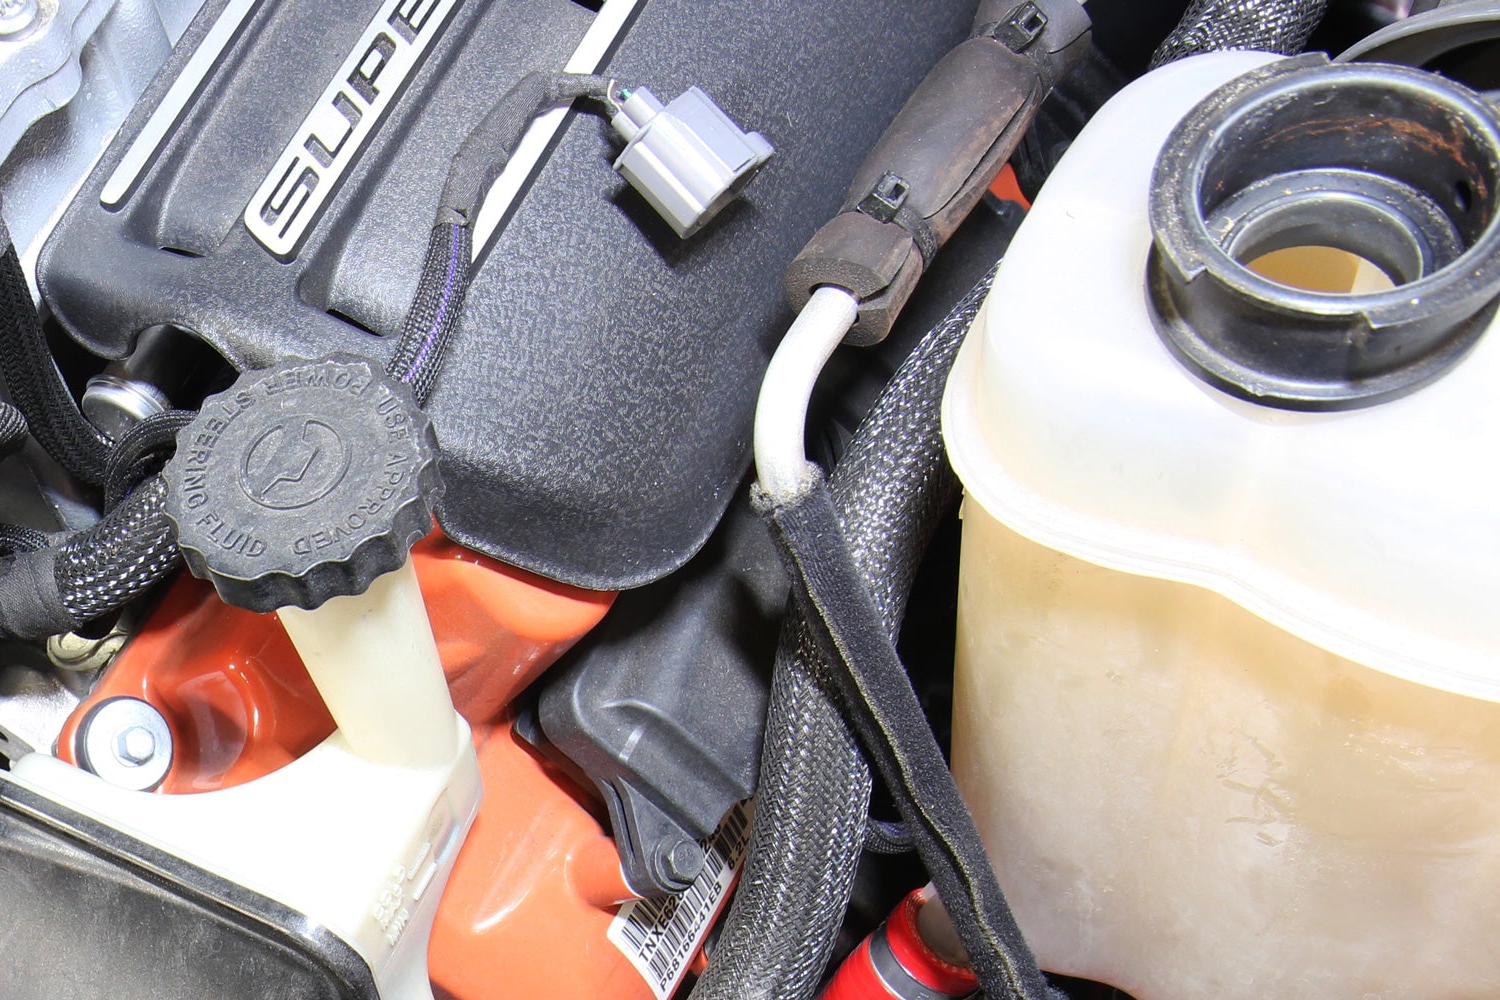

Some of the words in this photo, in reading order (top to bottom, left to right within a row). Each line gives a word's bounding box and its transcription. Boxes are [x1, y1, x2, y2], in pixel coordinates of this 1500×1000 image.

[264, 370, 372, 397] POWER
[375, 394, 411, 445] USE
[183, 389, 257, 510] STEERING
[291, 450, 410, 557] APPROVED
[195, 511, 270, 559] FLUID
[726, 836, 752, 872] 6.2L
[659, 882, 724, 993] P68166441EB
